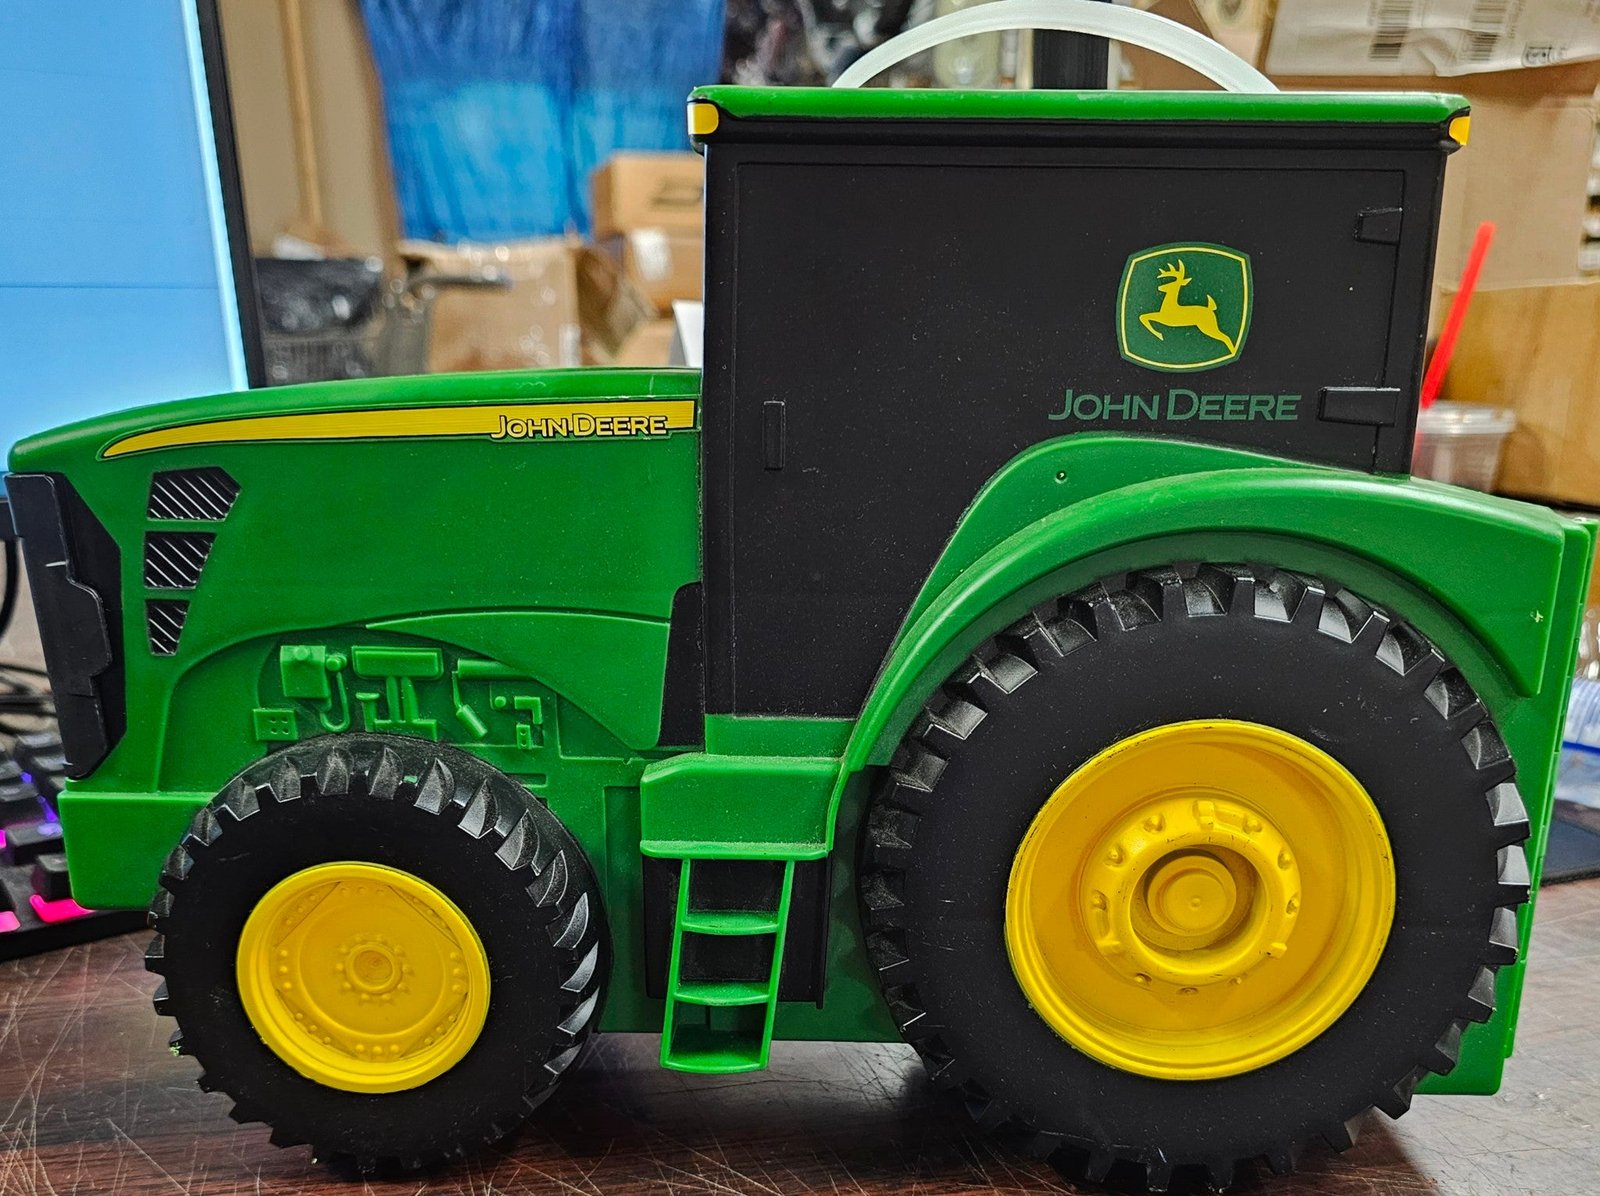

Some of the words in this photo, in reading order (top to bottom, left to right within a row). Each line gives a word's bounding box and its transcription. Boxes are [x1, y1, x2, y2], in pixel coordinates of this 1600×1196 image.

[1048, 388, 1160, 421] JOHN
[1166, 388, 1301, 421] DEERE
[490, 415, 569, 439] JOHN
[571, 413, 668, 438] DEERE
